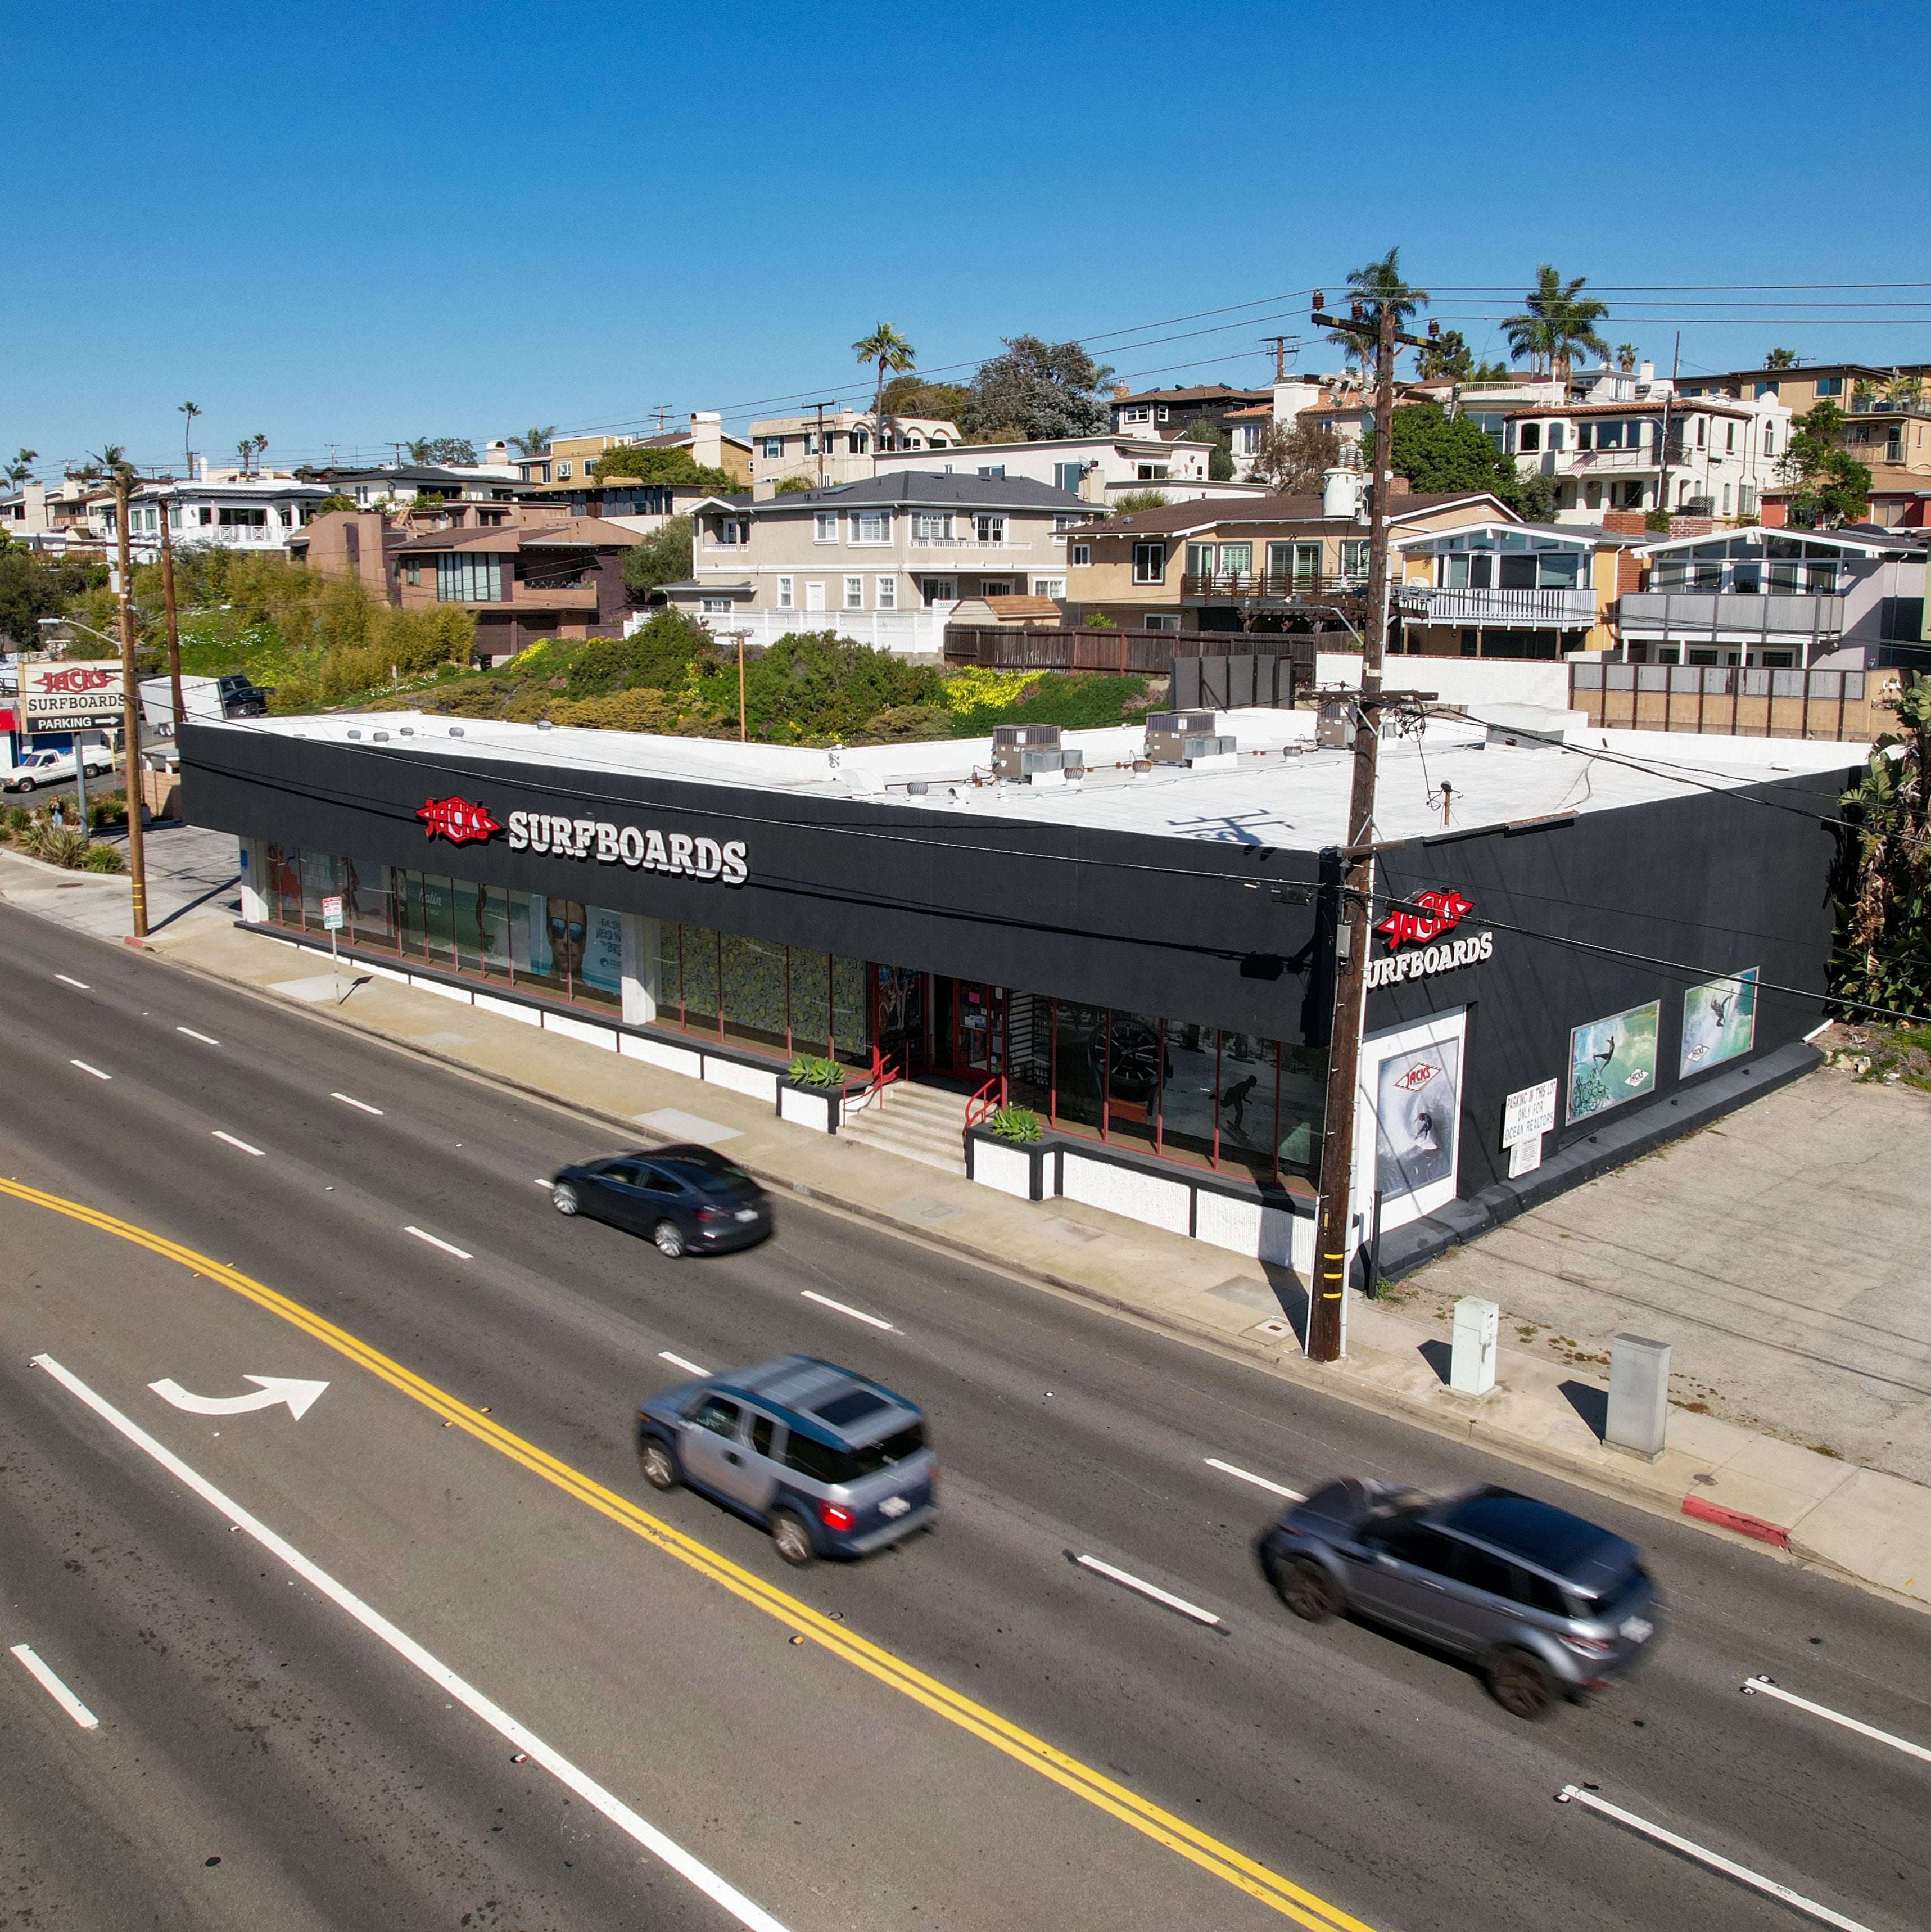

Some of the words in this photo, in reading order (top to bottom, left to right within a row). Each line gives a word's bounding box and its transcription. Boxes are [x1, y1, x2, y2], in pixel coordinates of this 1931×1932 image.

[29, 696, 125, 711] SURFBOARDS
[38, 717, 92, 730] PARKING
[509, 811, 748, 883] SURFBOARDS
[1367, 932, 1493, 988] URFBOARDS
[1507, 1091, 1527, 1111] PARKING
[1528, 1089, 1534, 1103] IN
[1536, 1085, 1546, 1100] THIS
[1547, 1081, 1555, 1096] LOT
[1518, 1104, 1532, 1122] ONLY
[1532, 1100, 1544, 1116] FOR
[1505, 1122, 1524, 1141] OCEAN
[1526, 1111, 1554, 1133] REALTORS
